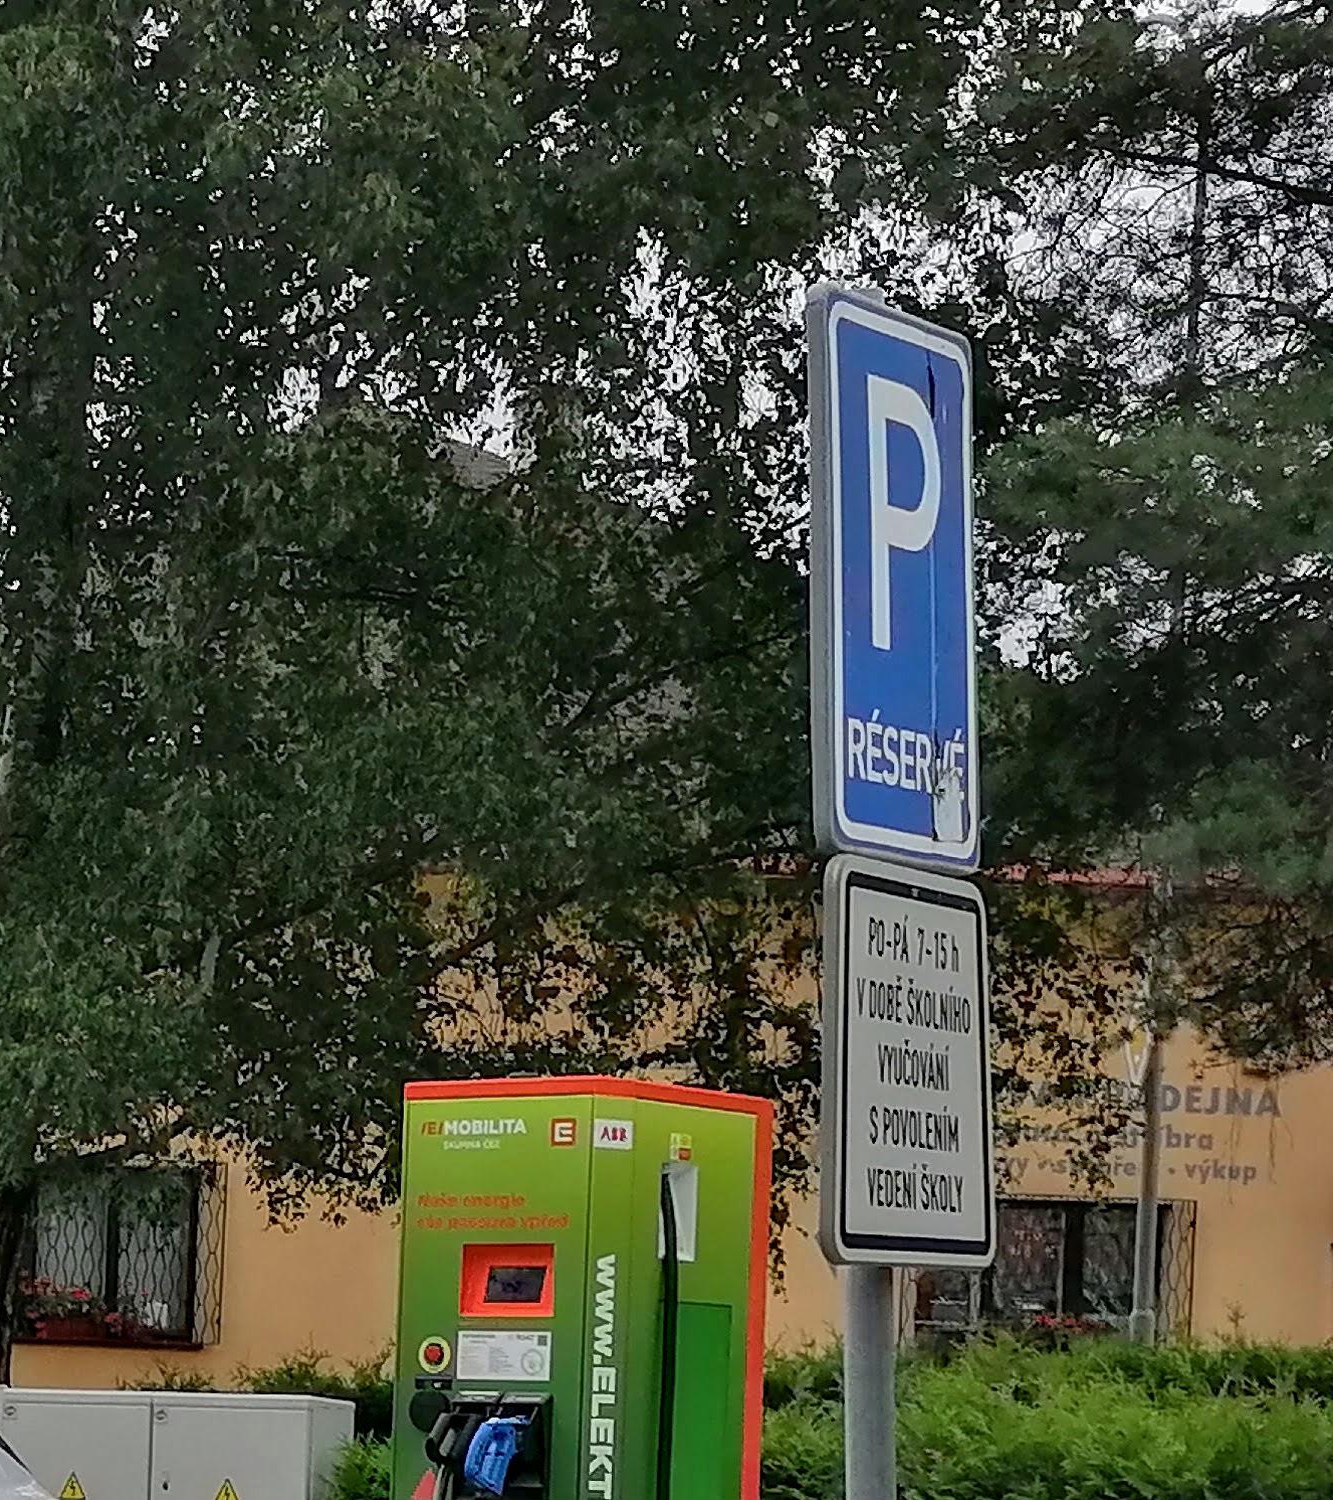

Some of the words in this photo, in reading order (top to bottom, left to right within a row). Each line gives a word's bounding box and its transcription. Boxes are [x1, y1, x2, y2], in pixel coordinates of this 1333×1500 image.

[867, 373, 941, 650] P
[856, 976, 866, 1016] V
[869, 975, 903, 1023] DOBĚ
[906, 976, 971, 1034] ŠKOLNÍHO
[878, 1039, 949, 1091] VYUČOVÁNÍ
[869, 1105, 879, 1144] S
[882, 1105, 960, 1152] POVOLENÍM
[867, 1163, 917, 1210] VEDENÍ
[921, 1163, 964, 1213] ŠKOLY
[1186, 1157, 1257, 1184] výkup
